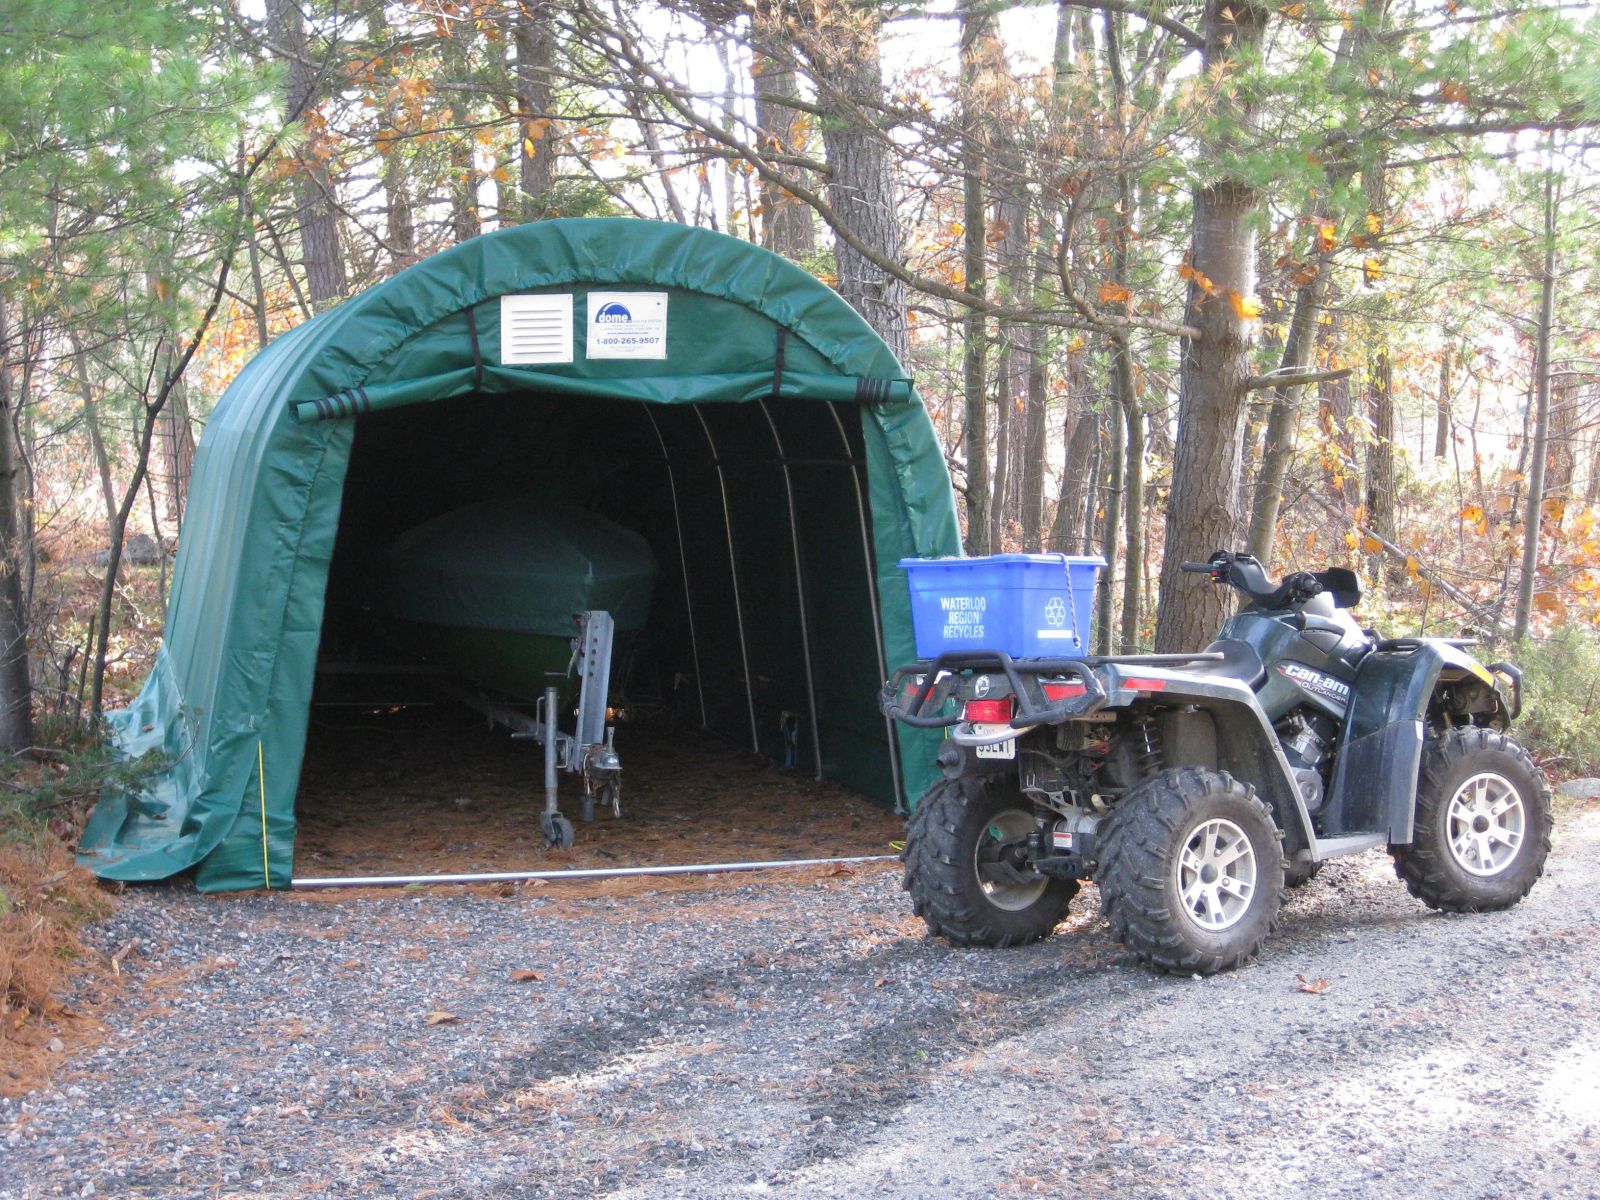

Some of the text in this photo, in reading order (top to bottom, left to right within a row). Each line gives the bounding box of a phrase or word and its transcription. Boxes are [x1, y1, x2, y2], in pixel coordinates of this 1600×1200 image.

[599, 312, 628, 324] dome
[597, 337, 660, 345] 1-800-265-9507
[941, 597, 986, 611] WATERLOO
[949, 611, 980, 625] REGION
[943, 625, 985, 639] RECYCLES
[1285, 665, 1350, 696] can-am
[1302, 681, 1347, 703] OUTLANDER
